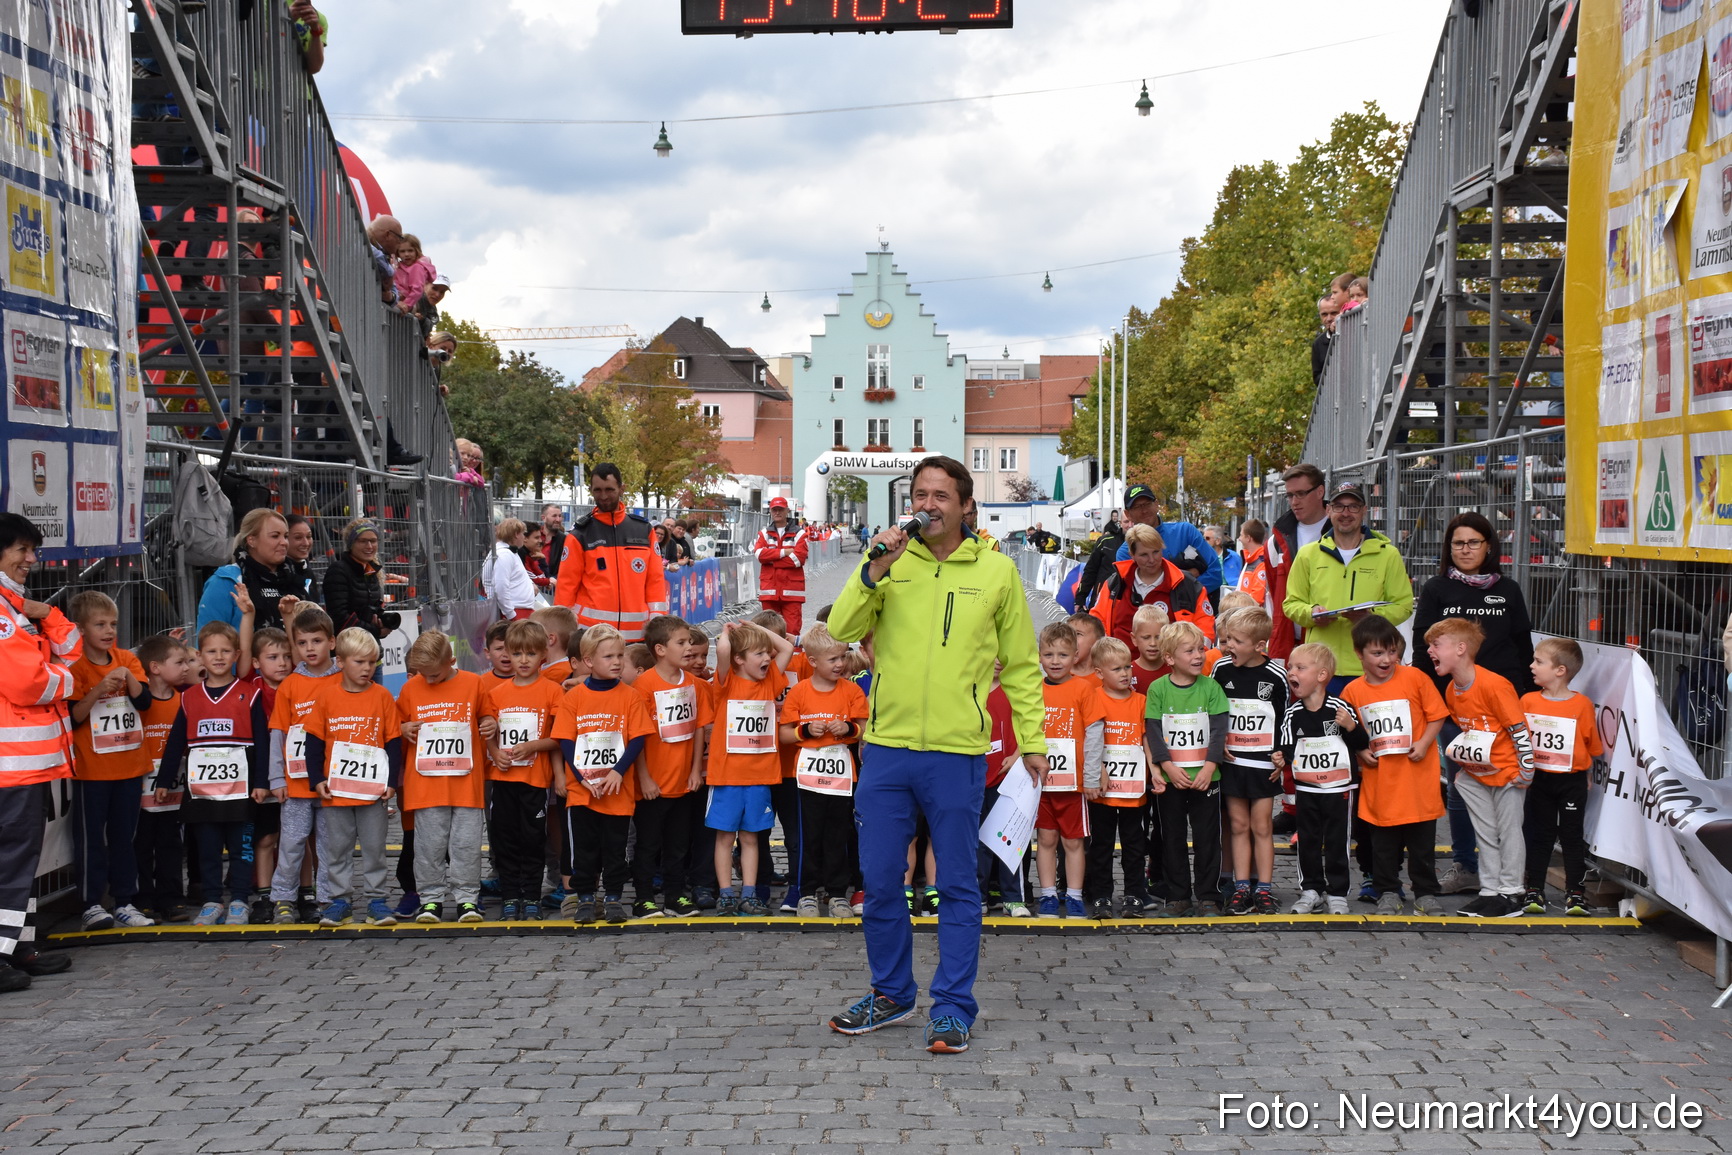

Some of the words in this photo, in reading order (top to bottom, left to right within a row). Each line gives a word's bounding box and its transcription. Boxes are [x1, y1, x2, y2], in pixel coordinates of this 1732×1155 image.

[834, 457, 868, 468] BMW
[1442, 606, 1461, 616] get
[1466, 607, 1506, 616] movin'
[664, 702, 694, 722] 7251
[99, 712, 135, 732] 7169
[199, 721, 232, 735] rytas
[736, 716, 769, 733] 7067
[1229, 715, 1266, 731] 7057
[500, 729, 529, 746] 194
[1168, 729, 1204, 746] 7314
[1234, 736, 1260, 744] Benjamin
[426, 738, 465, 755] 7070
[1453, 744, 1483, 762] 7216
[583, 748, 618, 766] 7265
[1299, 752, 1340, 769] 7087
[197, 763, 240, 780] 7233
[340, 759, 378, 779] 7211
[807, 757, 845, 775] 7030
[817, 778, 832, 786] Elias
